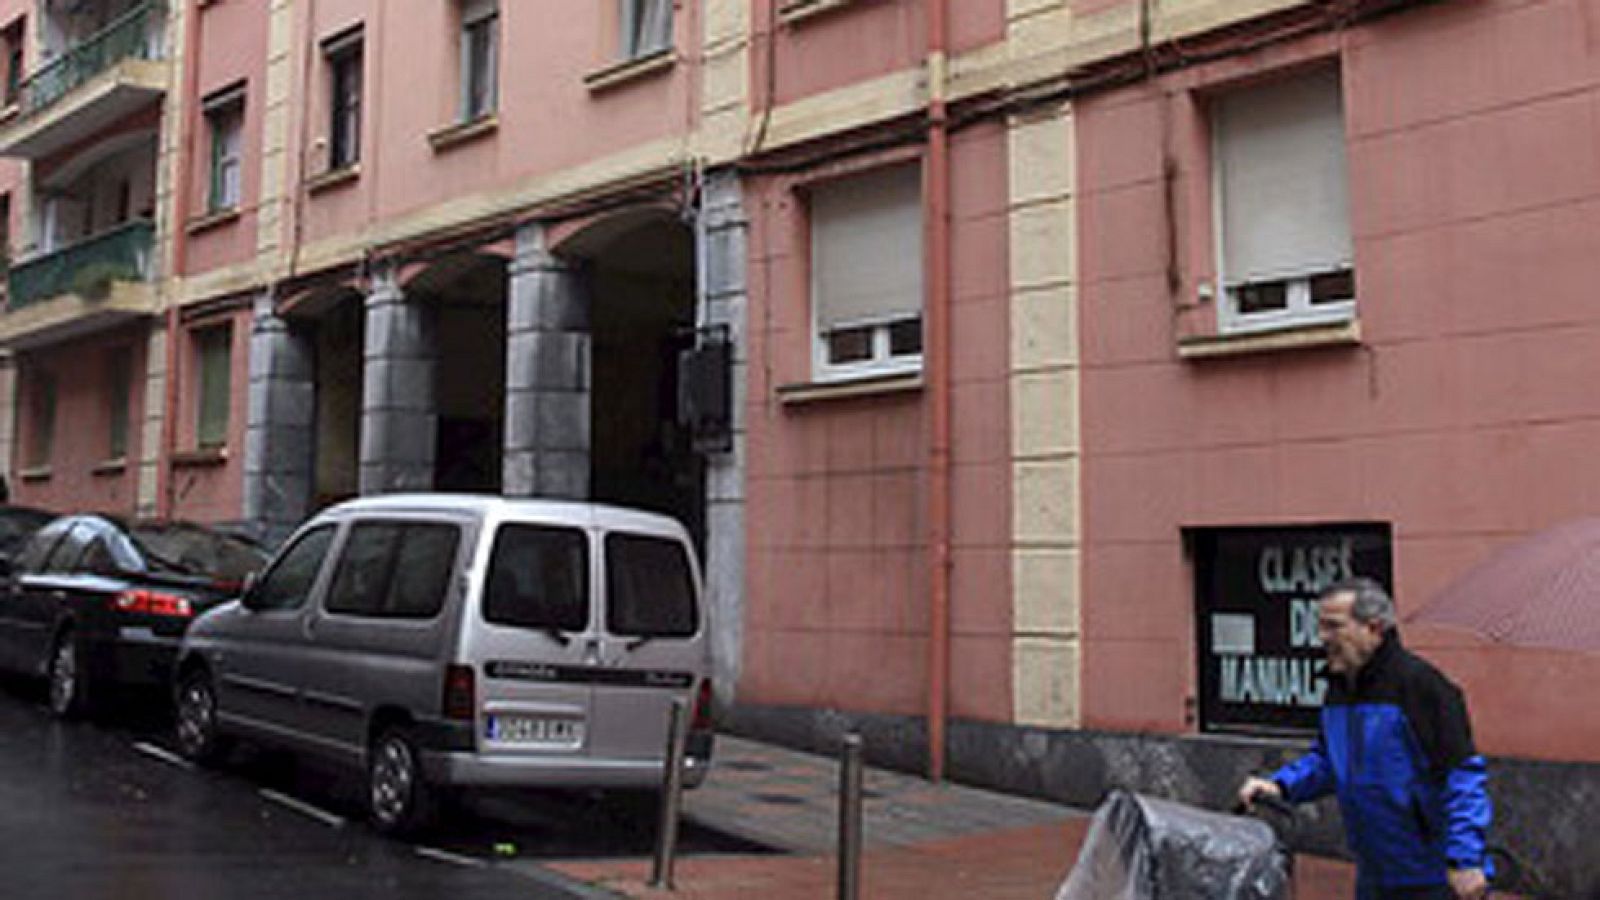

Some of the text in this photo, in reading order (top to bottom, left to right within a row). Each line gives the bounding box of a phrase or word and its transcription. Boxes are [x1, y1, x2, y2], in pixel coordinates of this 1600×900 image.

[1260, 541, 1353, 593] CLASES
[1290, 599, 1324, 647] DE
[1220, 657, 1329, 707] MANUALI
